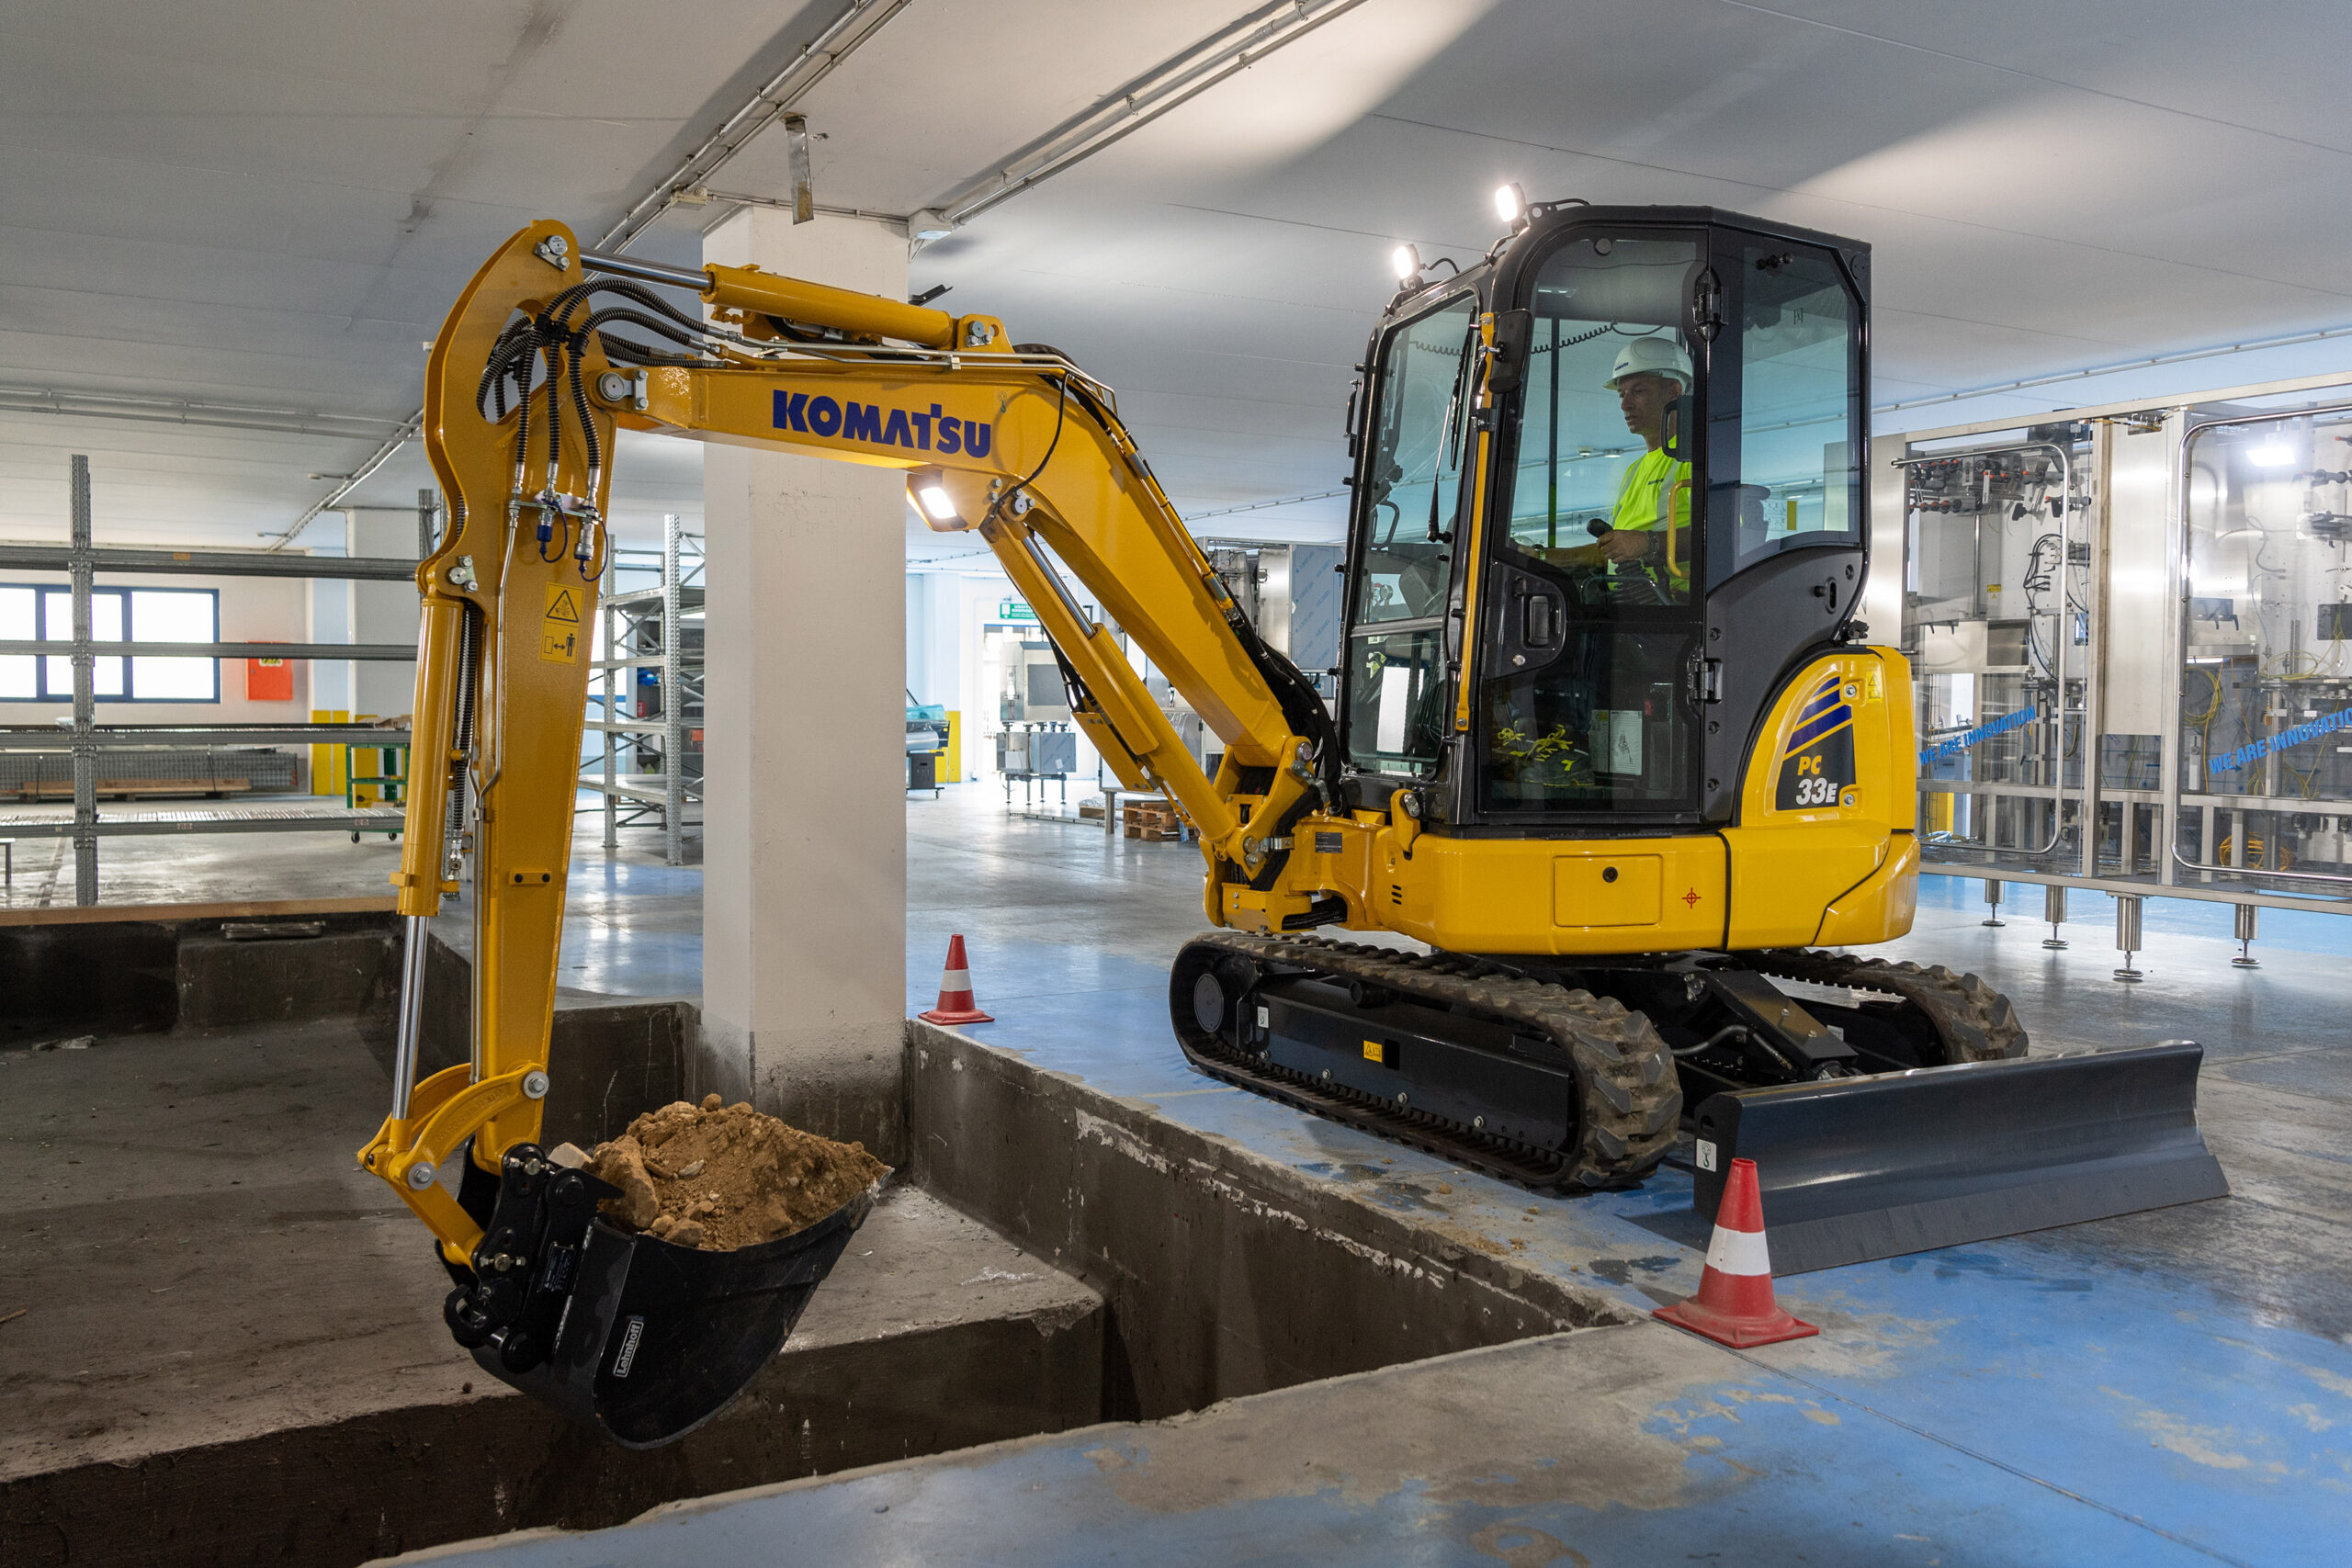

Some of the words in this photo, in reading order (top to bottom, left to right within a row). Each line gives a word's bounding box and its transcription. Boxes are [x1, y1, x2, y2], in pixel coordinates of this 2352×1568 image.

[773, 389, 991, 458] KOMATSU
[1918, 747, 1937, 766] WE
[1939, 736, 1962, 758] ARE
[1963, 705, 2036, 746] INNOVATION
[2209, 751, 2233, 774] WE
[2236, 739, 2267, 765] ARE
[1797, 755, 1822, 776] PC
[1796, 777, 1838, 806] 33E
[616, 1324, 641, 1374] Lehnhoff
